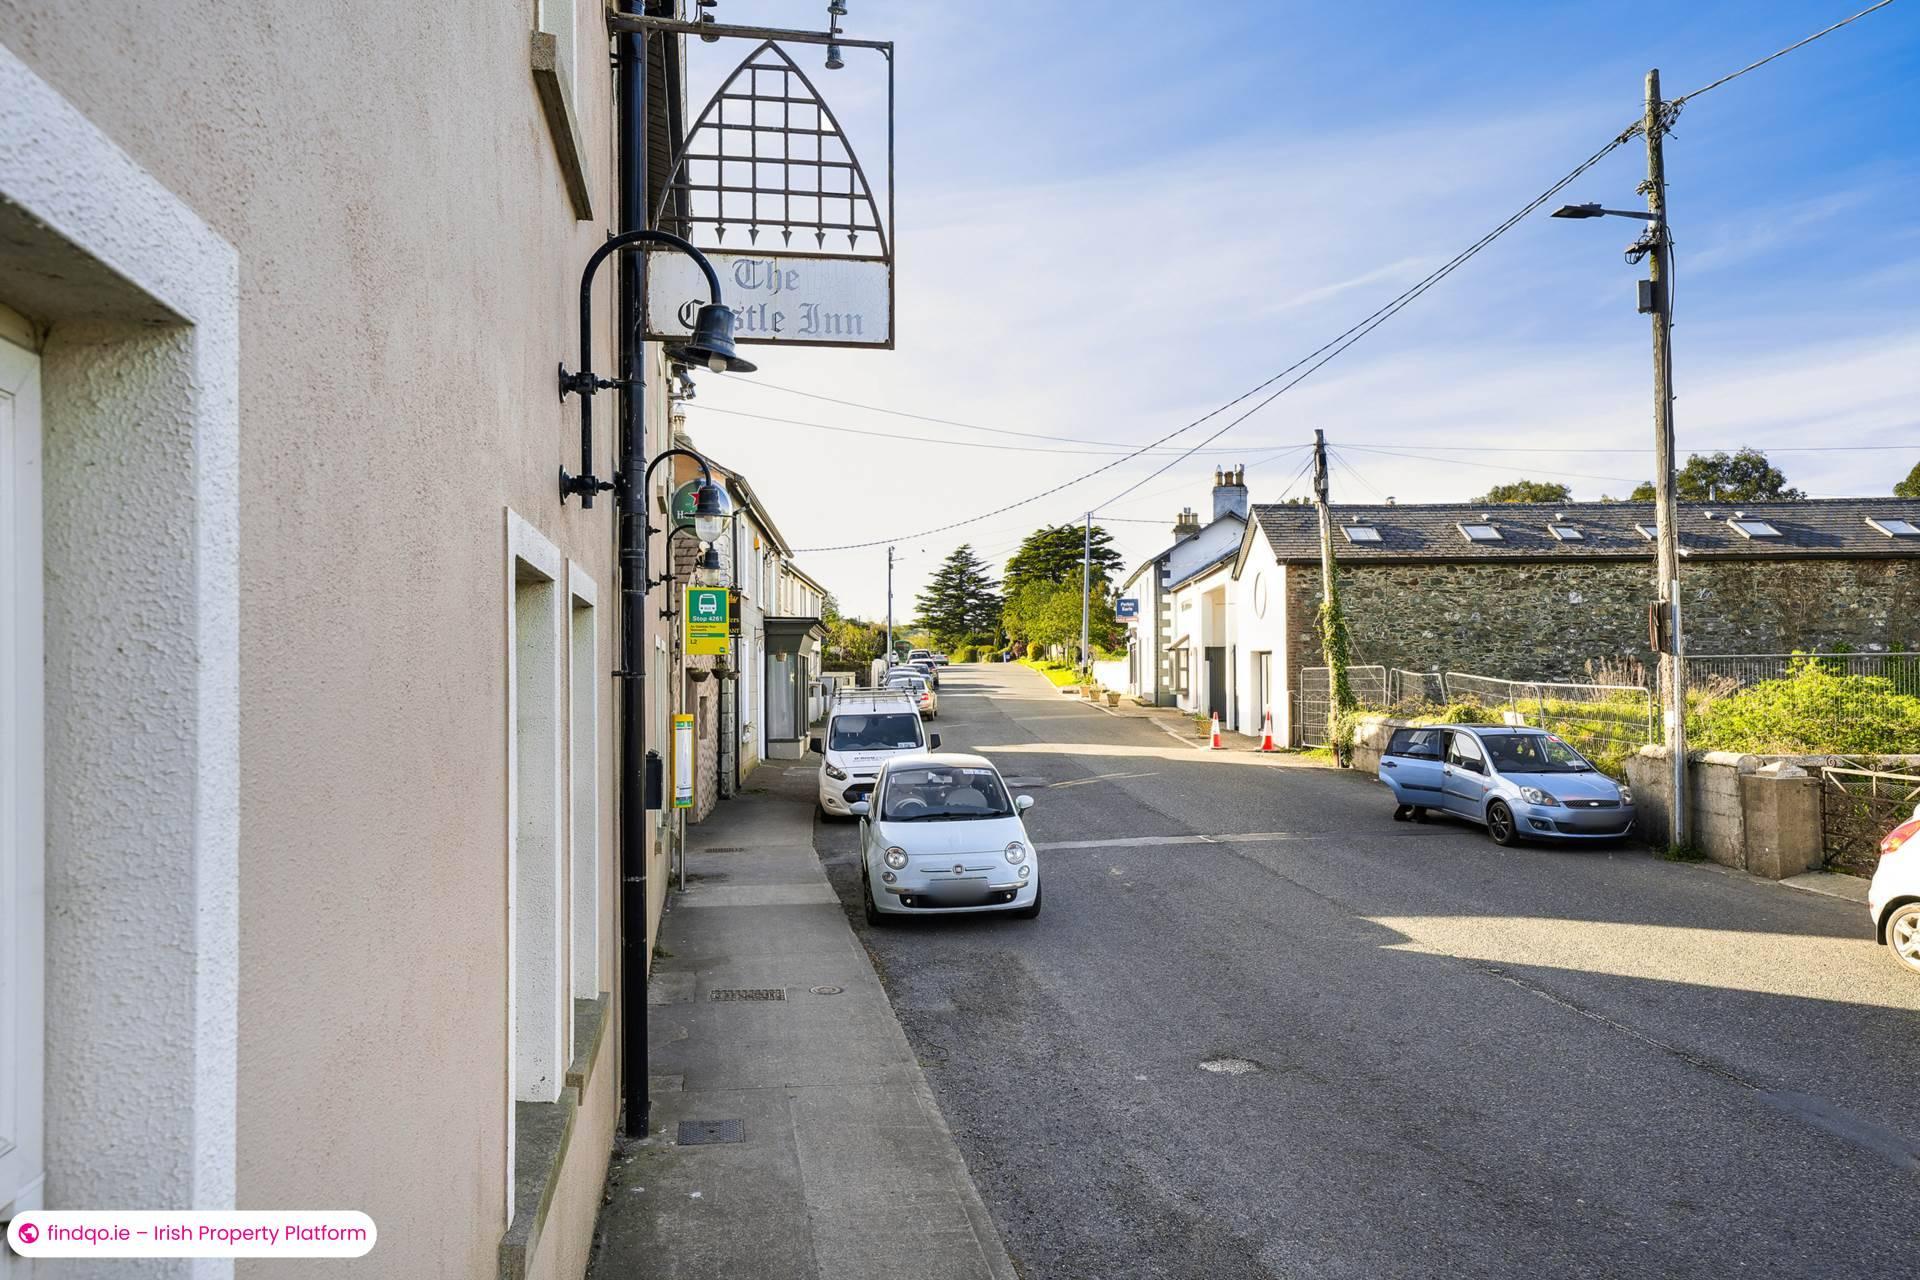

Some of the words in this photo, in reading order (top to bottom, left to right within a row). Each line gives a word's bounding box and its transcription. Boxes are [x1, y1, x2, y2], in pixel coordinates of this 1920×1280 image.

[732, 259, 800, 296] The
[678, 299, 786, 334] Cstle
[798, 302, 864, 336] Inn
